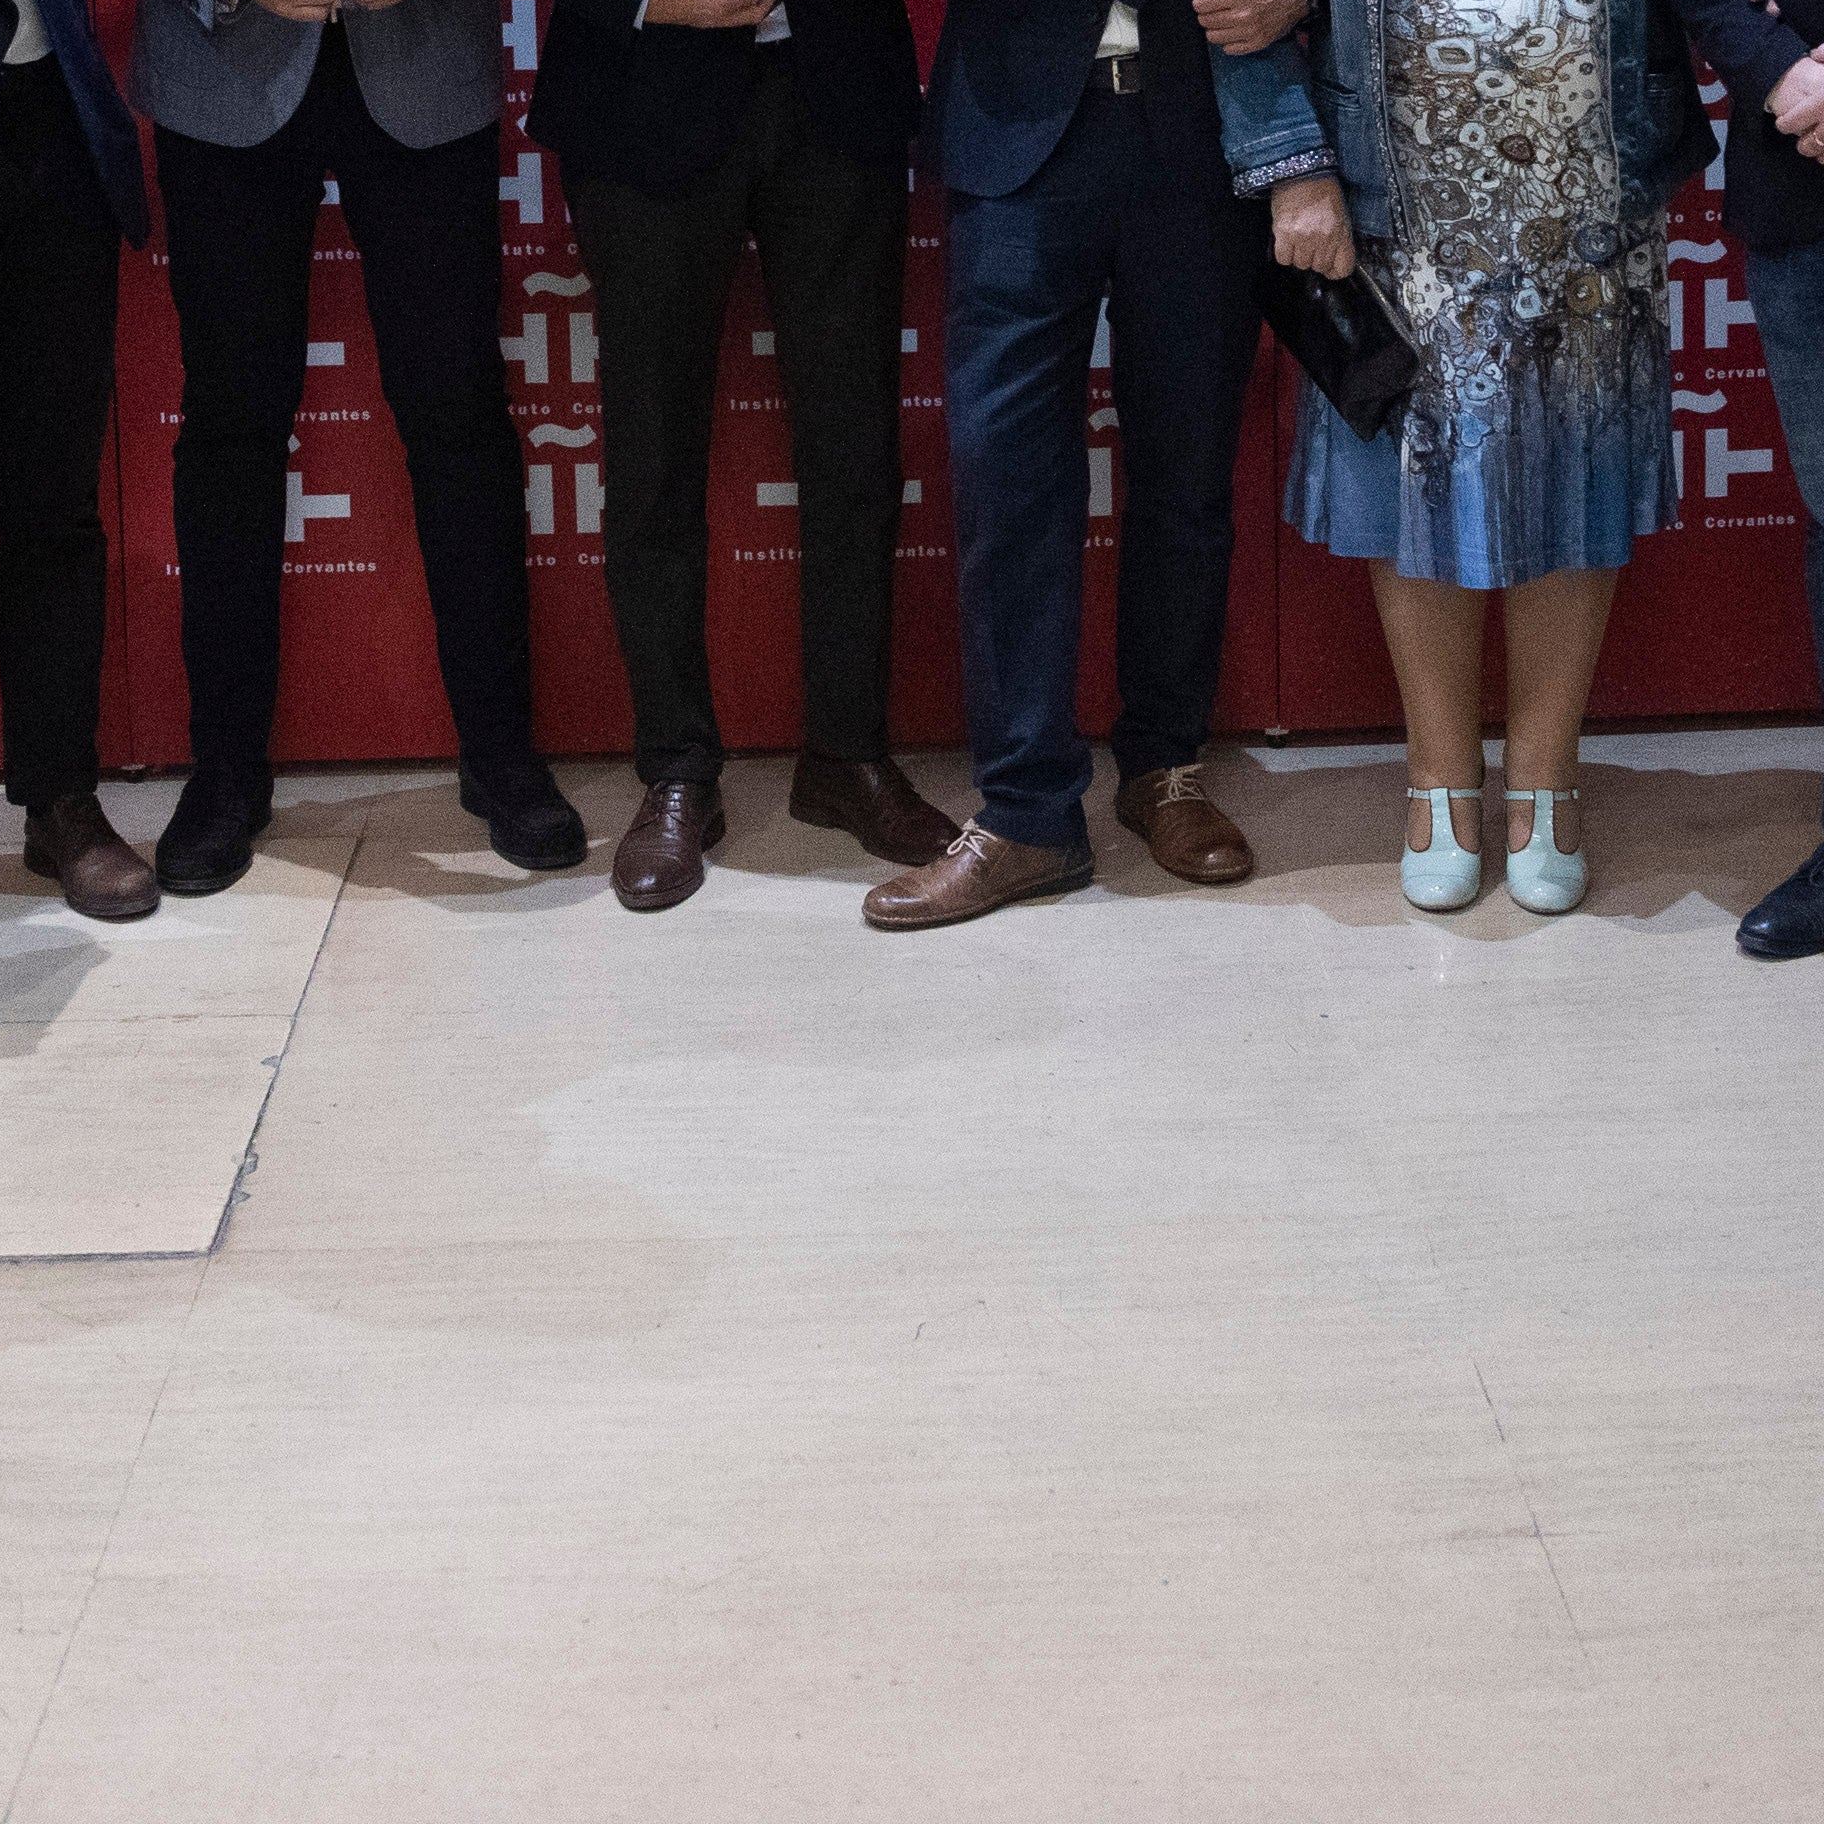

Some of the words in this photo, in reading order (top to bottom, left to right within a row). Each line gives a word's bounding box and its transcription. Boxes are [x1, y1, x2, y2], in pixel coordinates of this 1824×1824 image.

[1705, 366, 1767, 380] Cervan
[294, 409, 371, 422] rvantes
[1705, 514, 1796, 528] Cervantes
[735, 547, 802, 561] Instit
[282, 560, 377, 574] Cervantes
